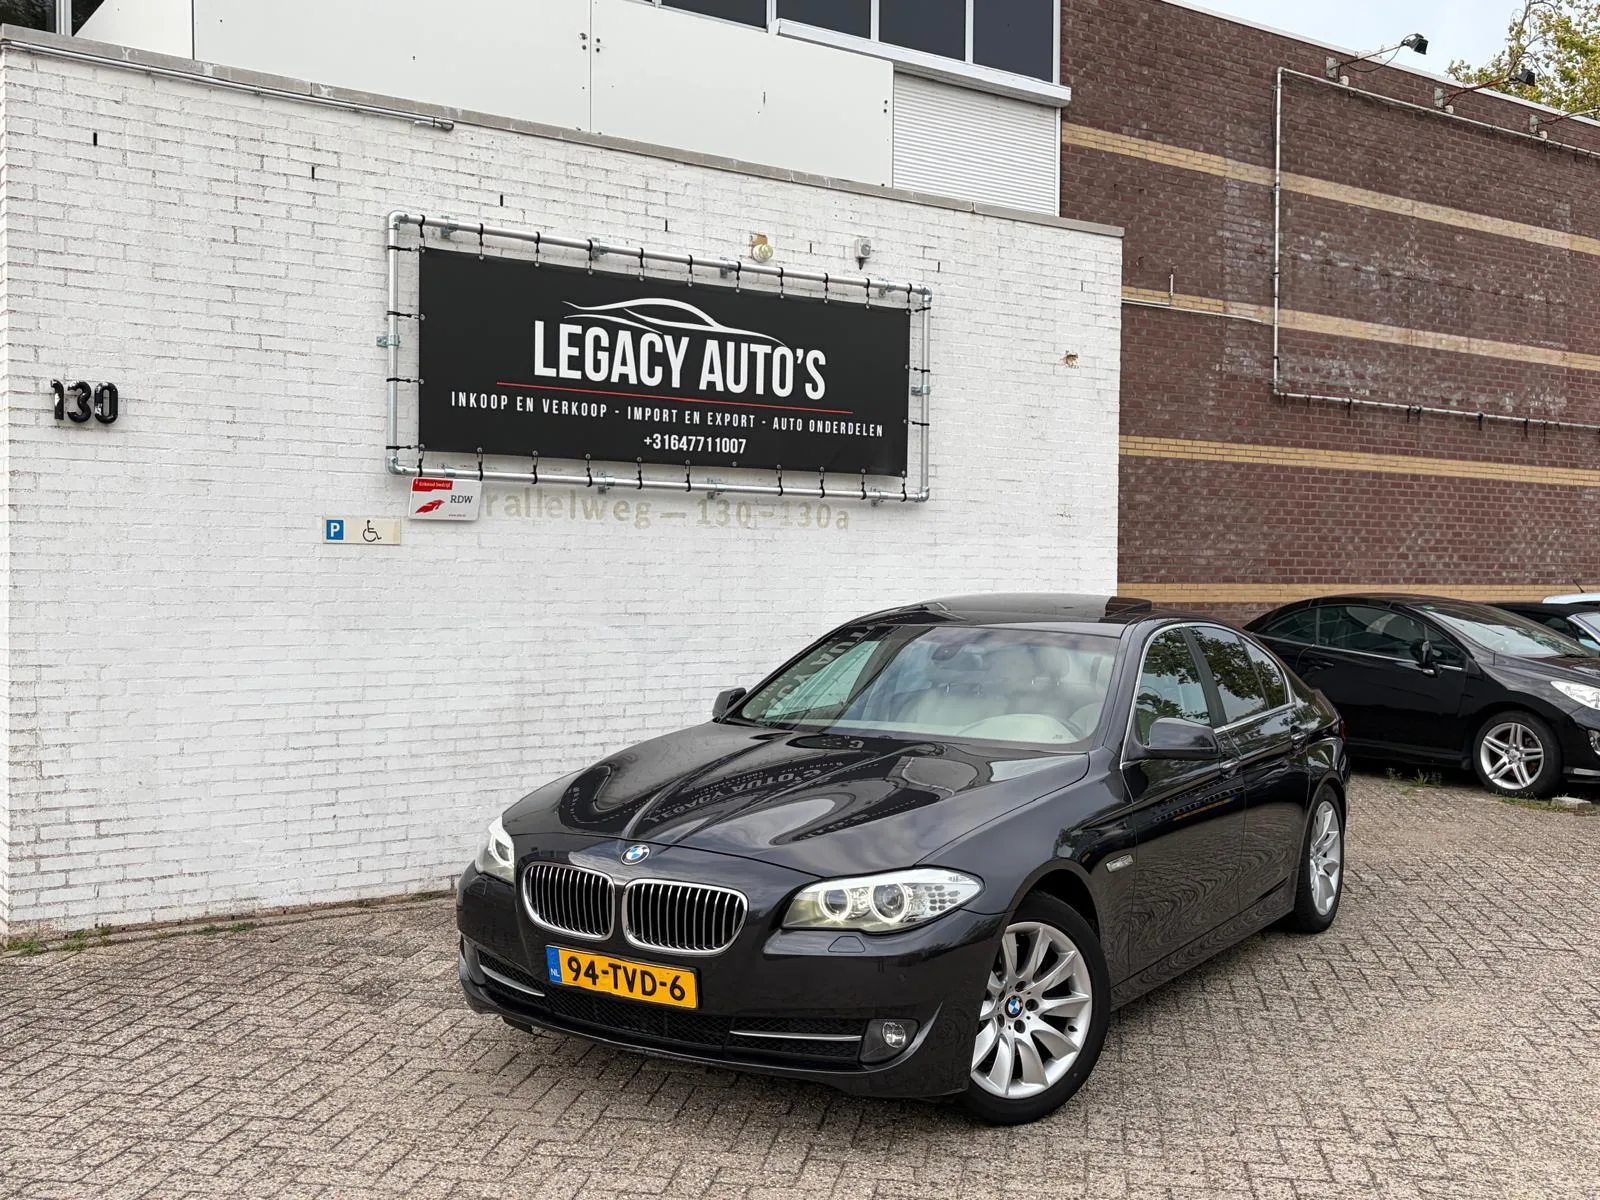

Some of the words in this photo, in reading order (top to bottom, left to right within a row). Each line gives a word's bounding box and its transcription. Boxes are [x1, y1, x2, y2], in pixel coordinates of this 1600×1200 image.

[534, 320, 690, 389] LEGACY
[699, 338, 827, 400] AUTO'S
[50, 378, 119, 424] 130
[451, 391, 508, 411] INKOOP
[516, 396, 534, 413] EN
[542, 398, 608, 418] VERKOOP
[627, 405, 678, 424] IMPORT
[685, 410, 701, 425] EN
[707, 411, 756, 428] EXPORT
[772, 416, 803, 432] AUTO
[809, 419, 884, 438] ONDERDELEN
[643, 433, 747, 454] +31647711007
[450, 494, 473, 504] RDW
[485, 487, 651, 529] rallelweg
[330, 522, 341, 537] P
[550, 967, 561, 978] NL
[567, 955, 686, 1001] 94-TVD-6
